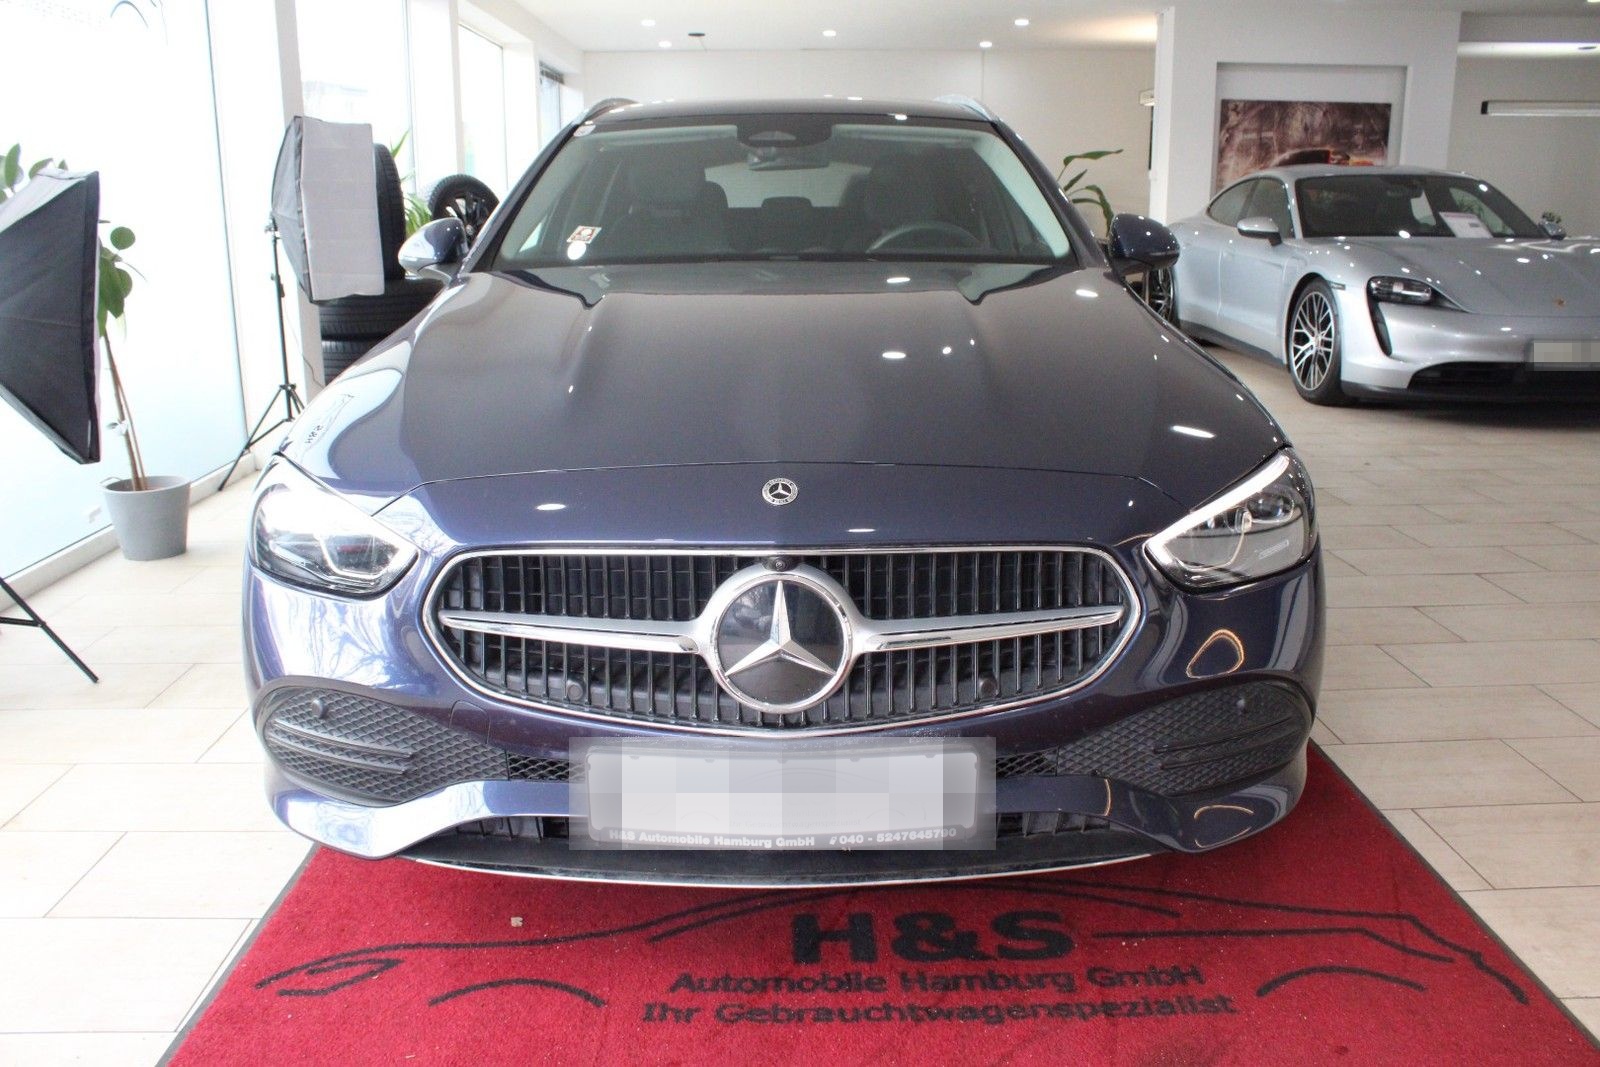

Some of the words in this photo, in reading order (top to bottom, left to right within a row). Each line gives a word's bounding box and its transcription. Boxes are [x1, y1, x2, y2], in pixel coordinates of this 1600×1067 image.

[608, 829, 636, 841] H&S
[638, 831, 711, 845] Automobile
[713, 835, 772, 848] Hamburg
[775, 836, 815, 847] GmbH
[838, 833, 864, 845] 040
[790, 910, 1076, 965] H&S
[669, 971, 888, 994] Automobile
[900, 968, 1078, 994] Hamburg
[1085, 965, 1206, 988] GmbH
[643, 1002, 702, 1024] Ihr
[715, 994, 1240, 1025] Gebrauchtwagenspezialist
